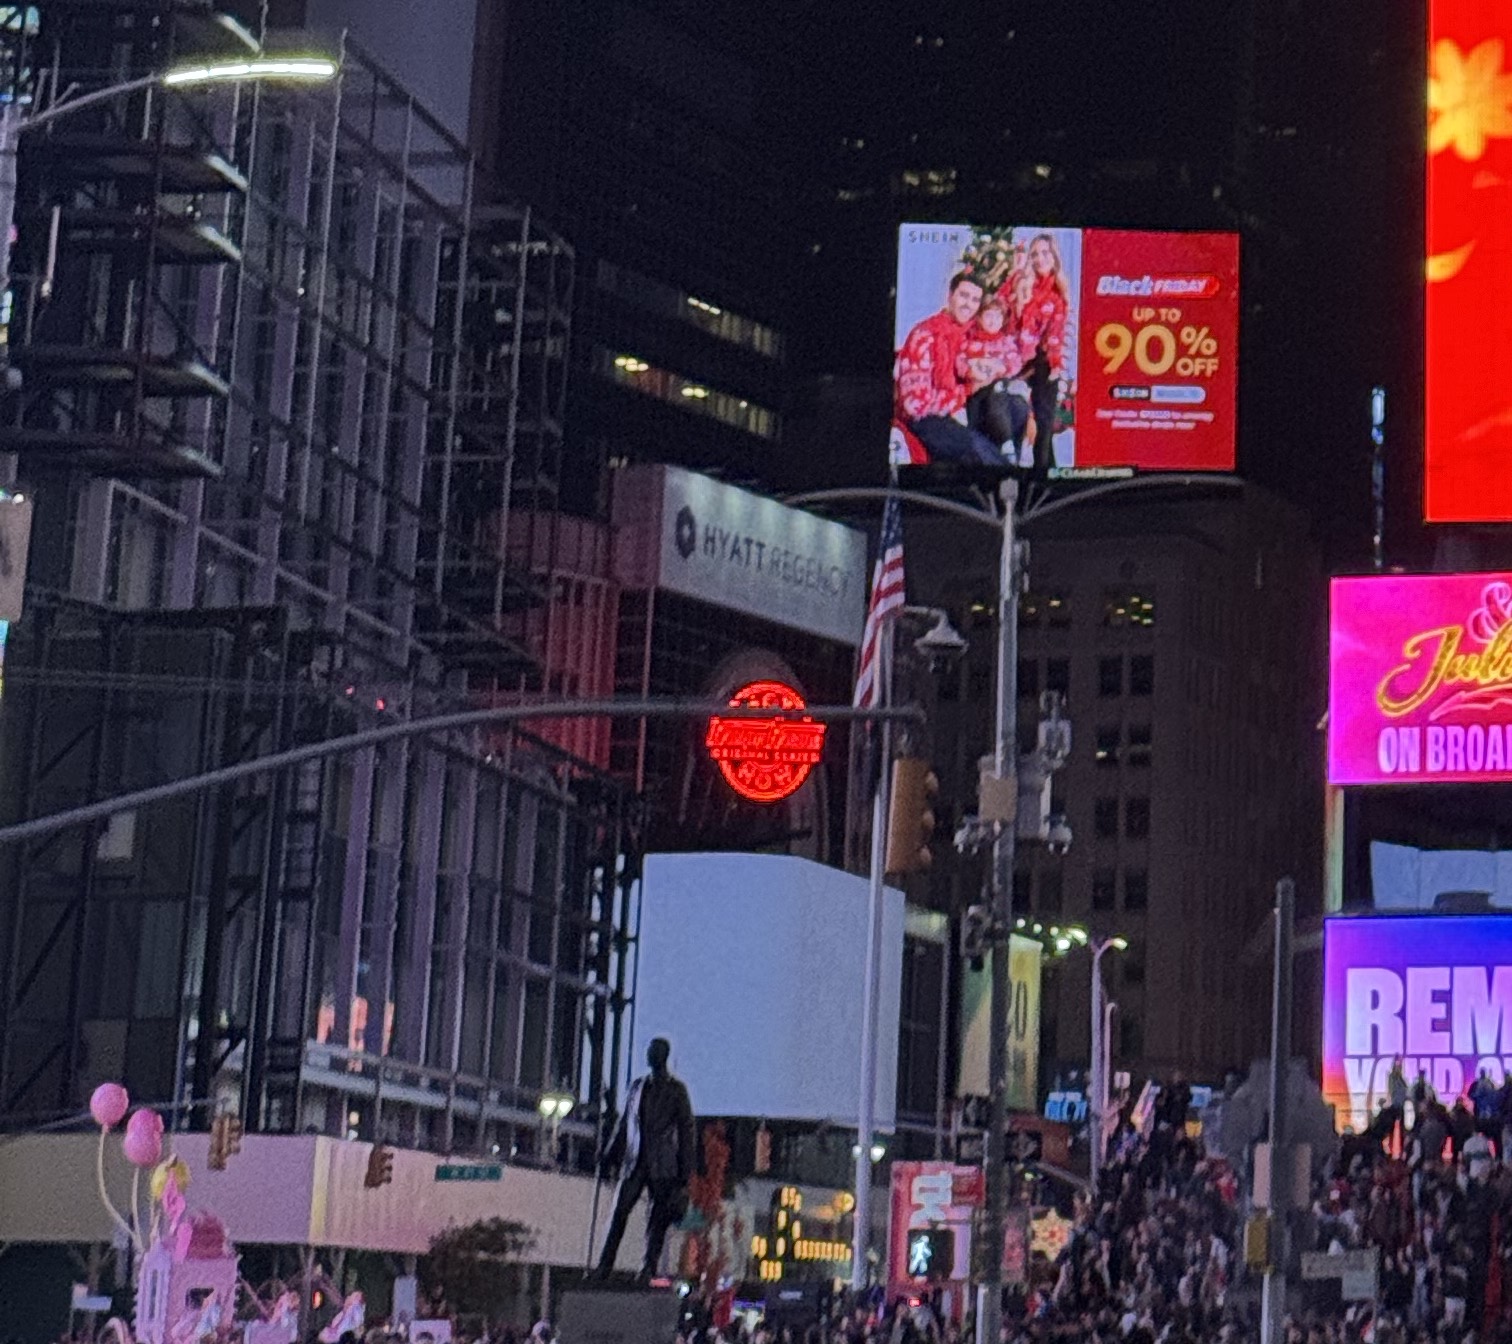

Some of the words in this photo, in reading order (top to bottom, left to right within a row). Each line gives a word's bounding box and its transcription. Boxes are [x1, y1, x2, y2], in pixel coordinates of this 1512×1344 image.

[1095, 274, 1153, 296] Black
[1131, 305, 1156, 323] UP
[1158, 307, 1182, 324] TO
[1175, 358, 1219, 378] OFF
[702, 522, 767, 571] HYATT
[1377, 726, 1421, 774] ON
[910, 1170, 953, 1230] tk
